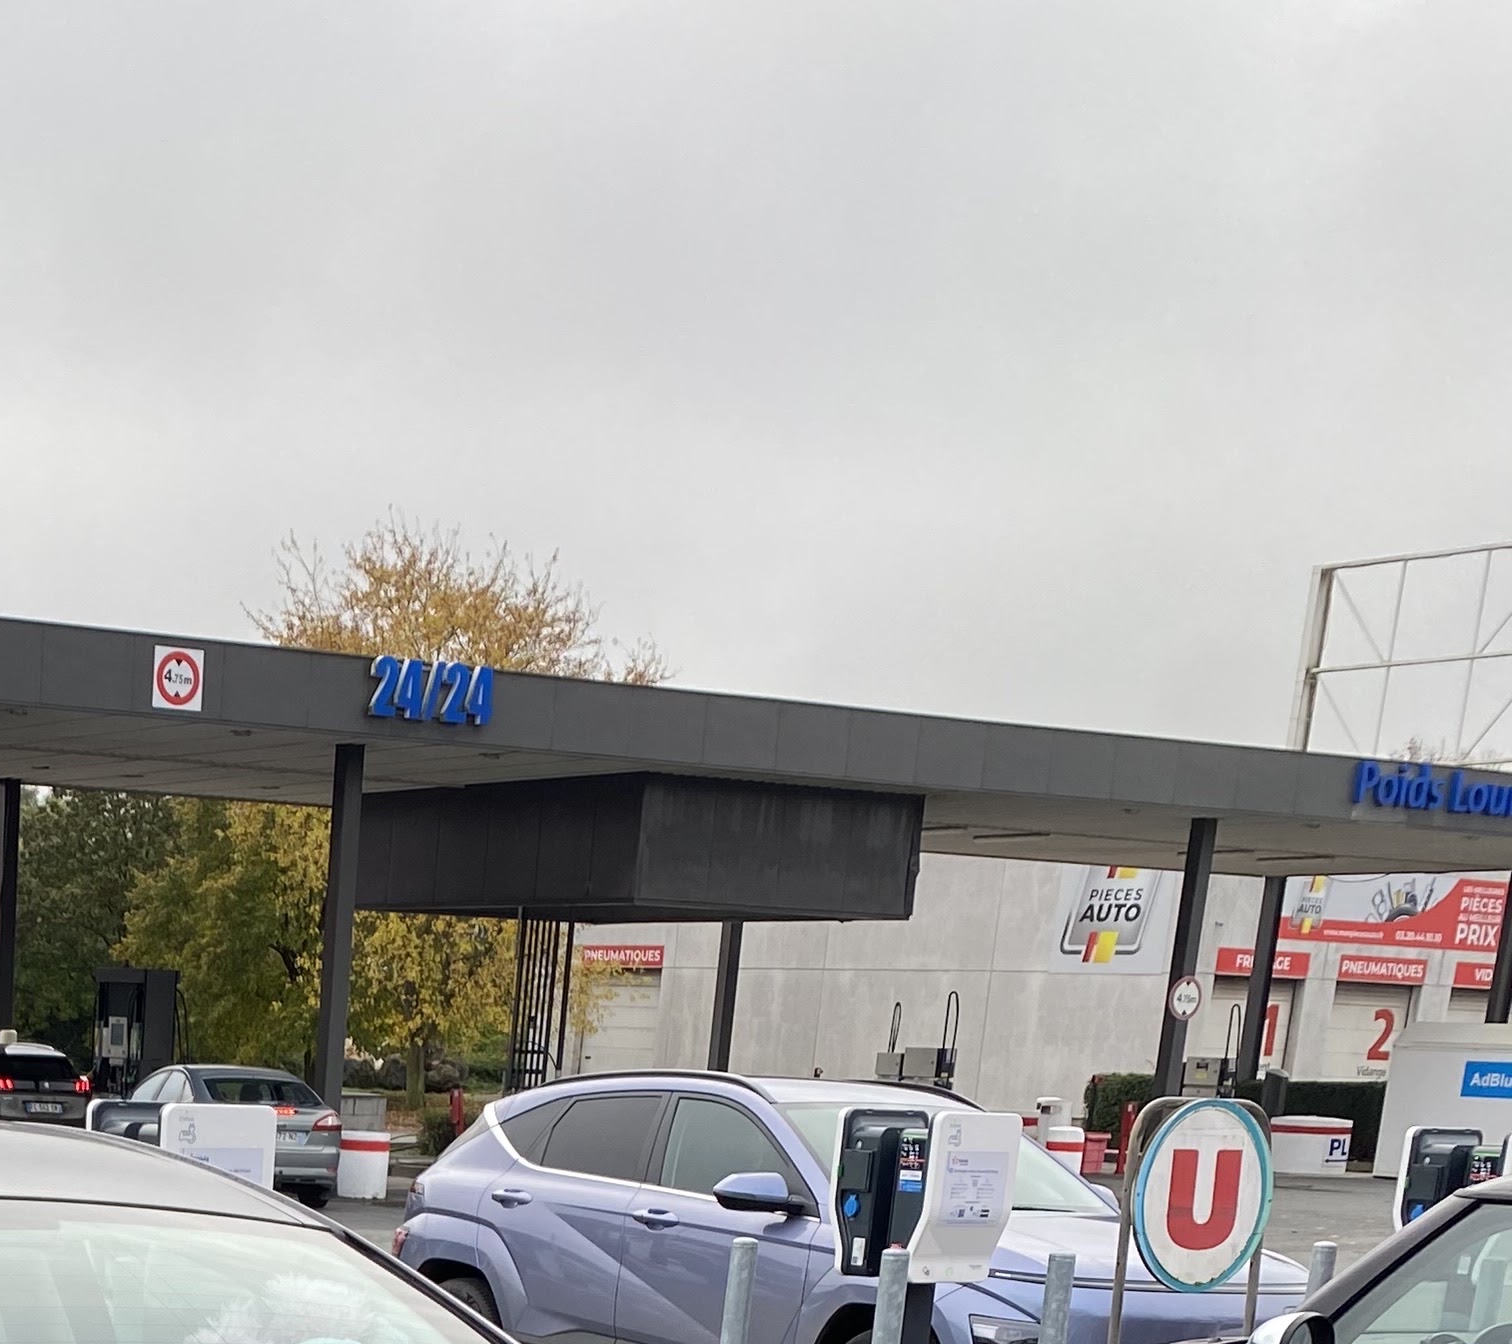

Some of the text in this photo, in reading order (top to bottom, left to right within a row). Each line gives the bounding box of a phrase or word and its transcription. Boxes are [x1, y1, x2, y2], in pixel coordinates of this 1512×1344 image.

[368, 655, 494, 726] 24/24
[1352, 760, 1445, 811] Poids
[1089, 888, 1144, 902] PIECES
[1079, 903, 1142, 923] AUTO
[1298, 903, 1322, 914] AUTO
[1454, 923, 1500, 947] PRIX
[584, 949, 661, 963] PNEUMATIQUES
[1341, 959, 1424, 979] PNEUMATIQUES
[1474, 967, 1493, 982] VID
[1367, 1009, 1395, 1061] 2
[1166, 1148, 1244, 1251] U
